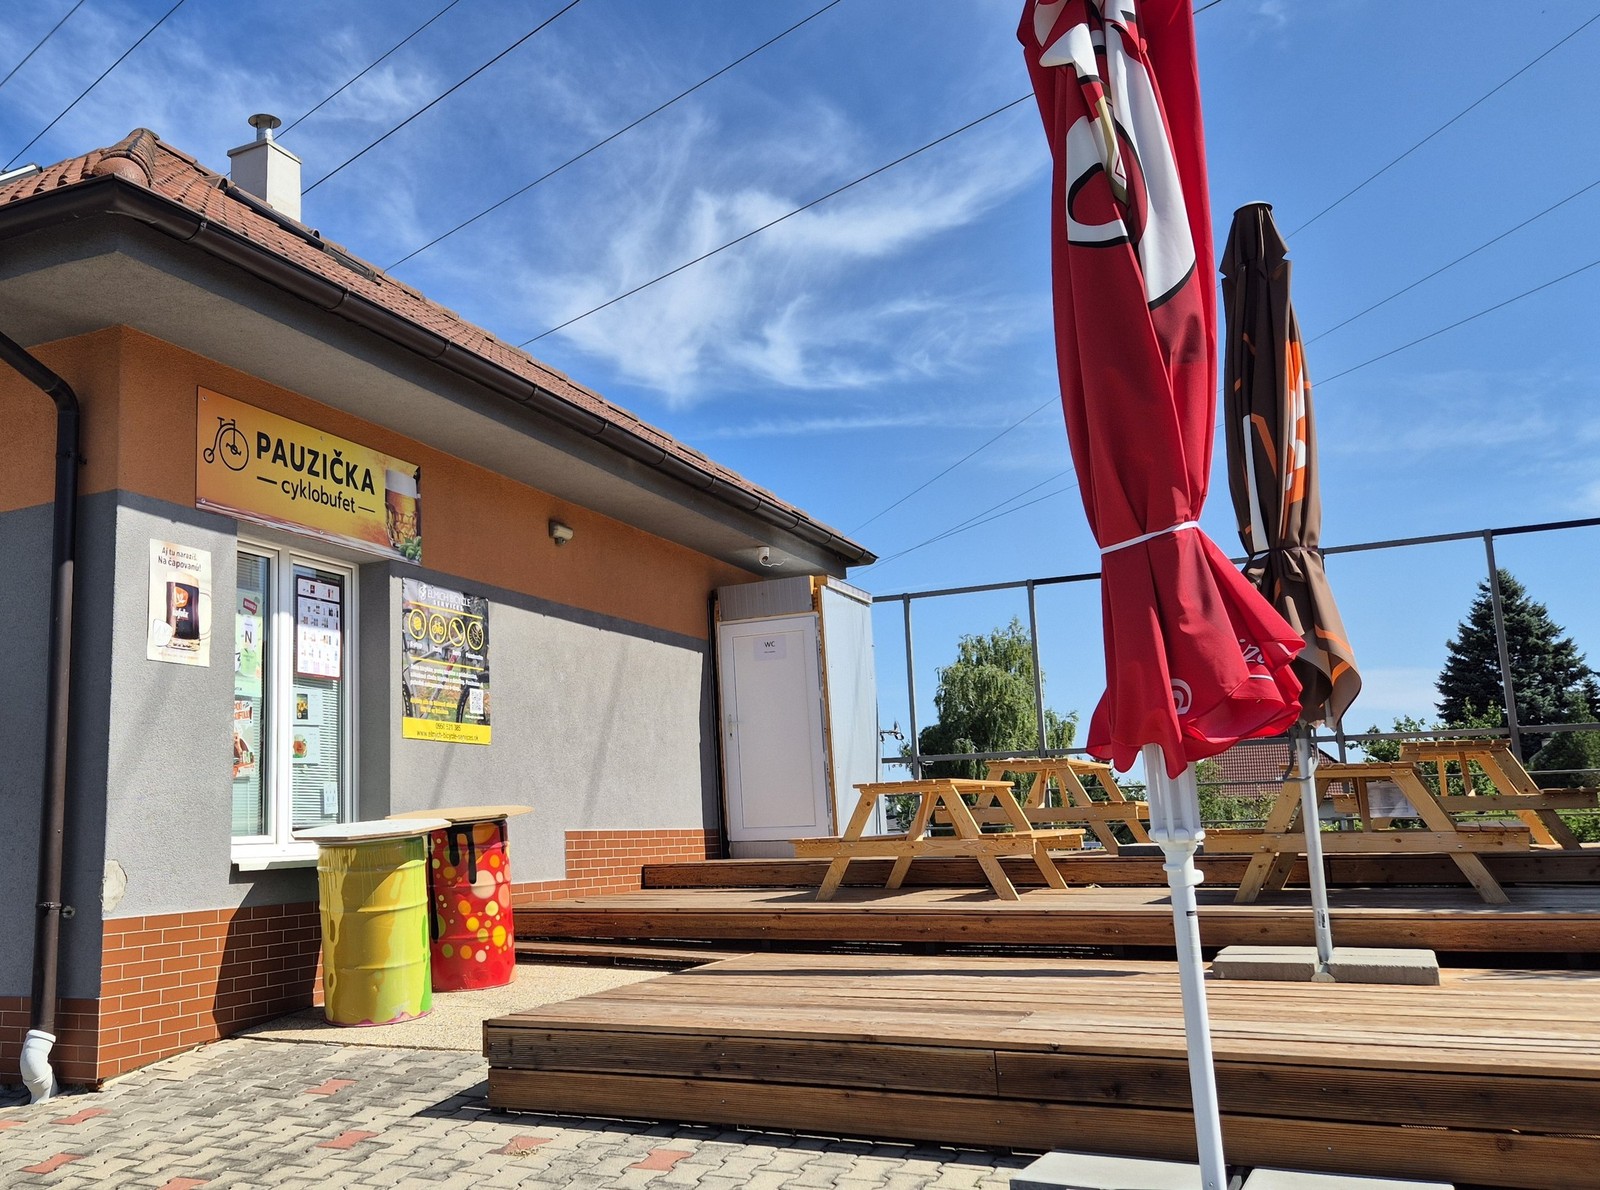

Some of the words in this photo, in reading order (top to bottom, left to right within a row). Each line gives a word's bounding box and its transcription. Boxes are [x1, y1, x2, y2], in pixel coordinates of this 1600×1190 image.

[256, 430, 375, 496] PAUZIČKA
[281, 479, 356, 514] cyklobufet
[158, 555, 166, 565] Na
[433, 600, 464, 612] SERVICES
[764, 640, 776, 648] WC
